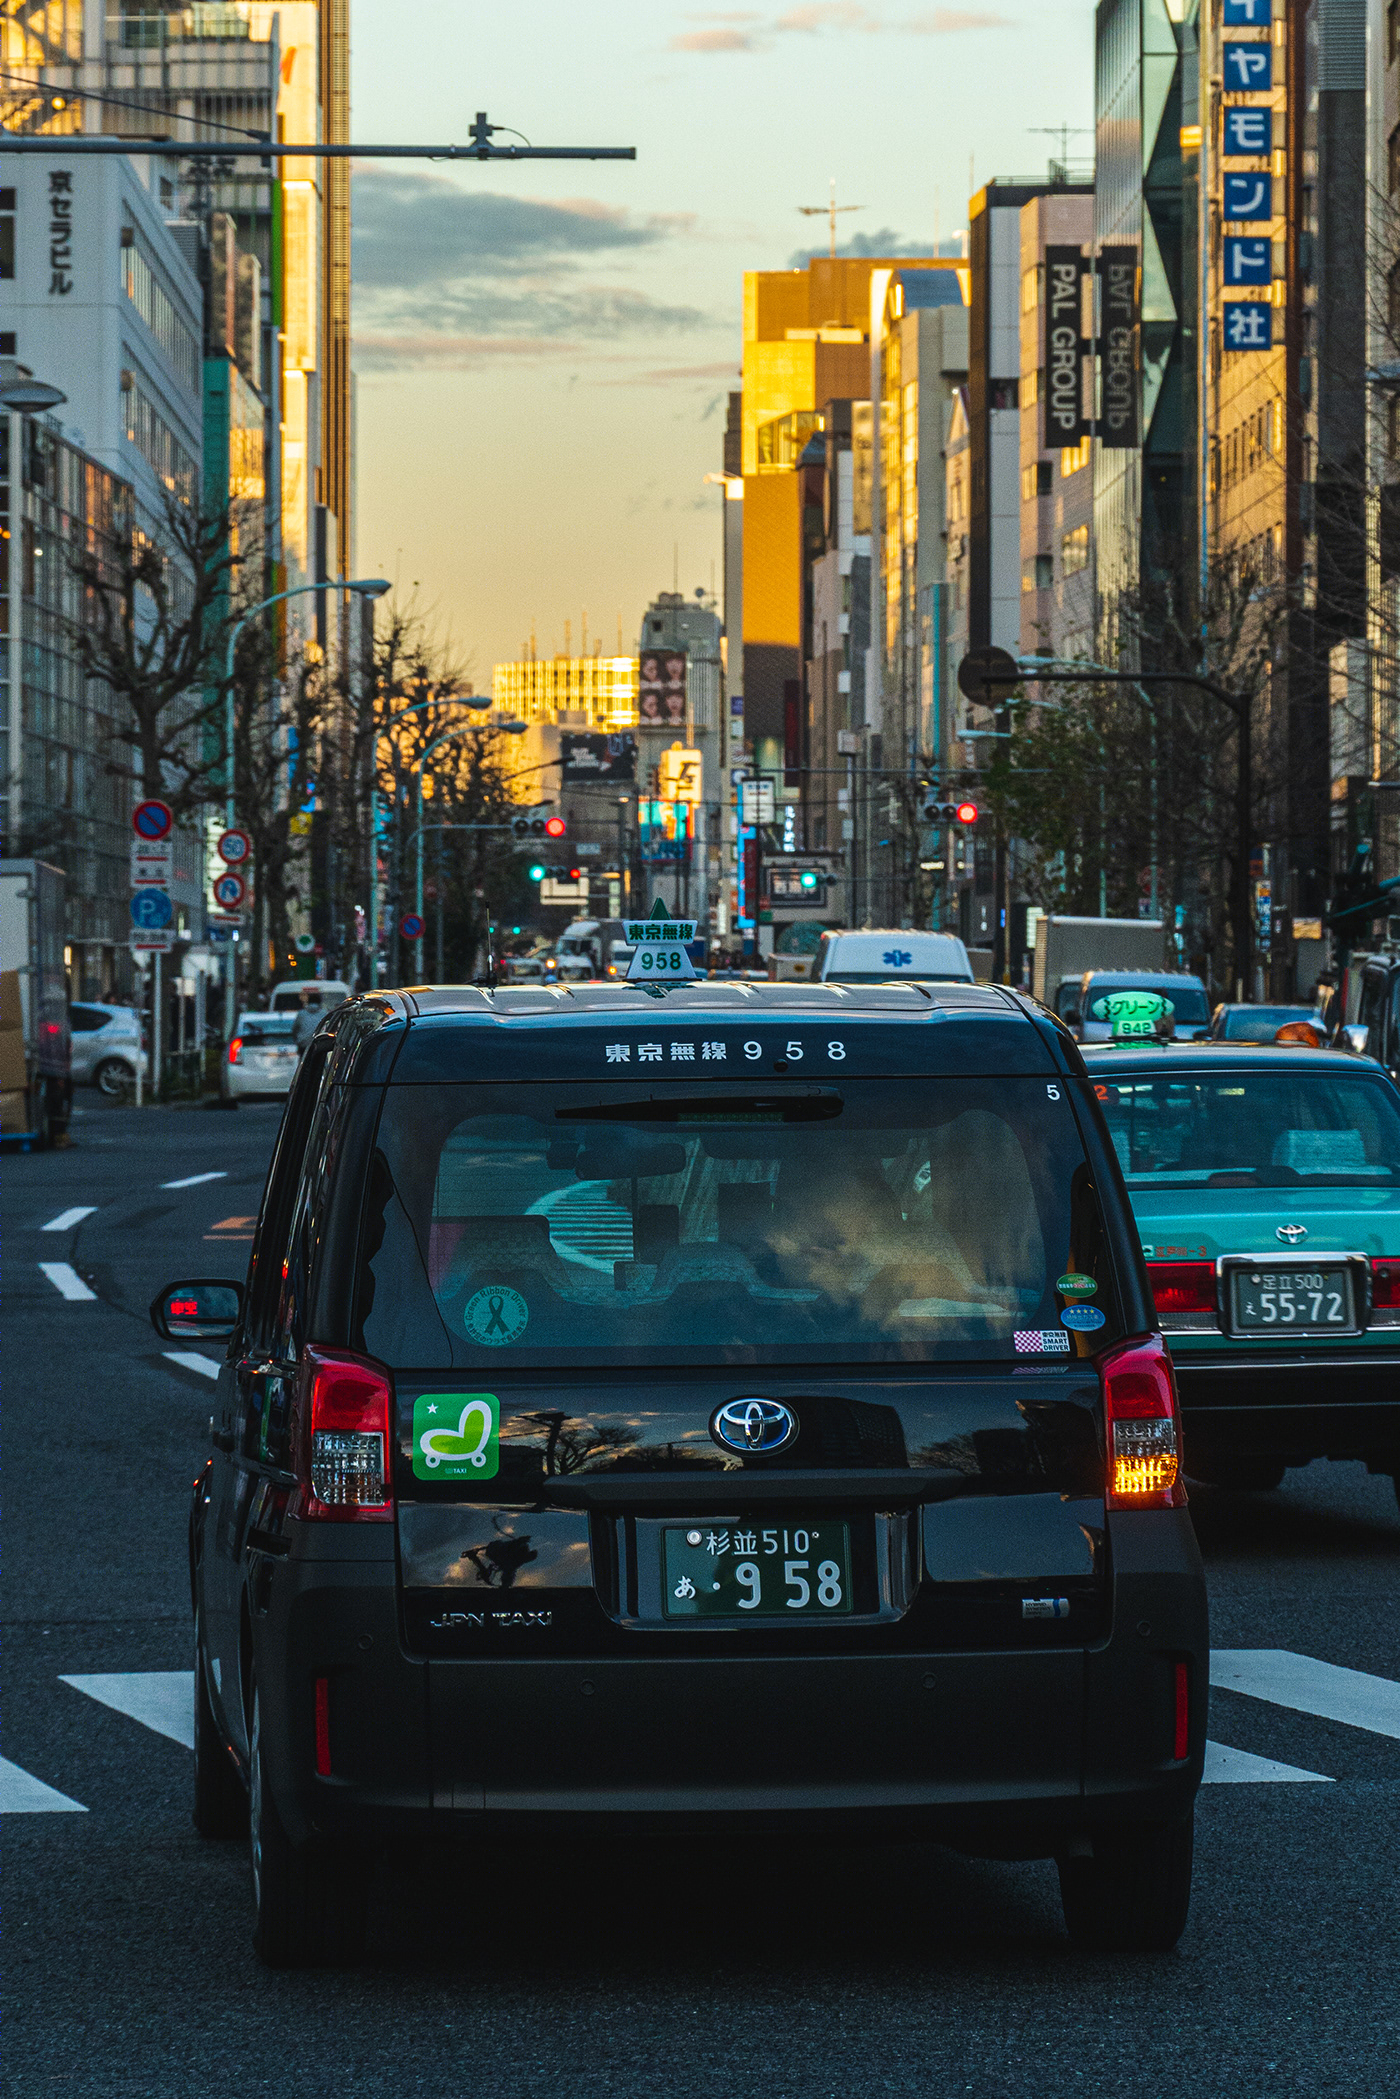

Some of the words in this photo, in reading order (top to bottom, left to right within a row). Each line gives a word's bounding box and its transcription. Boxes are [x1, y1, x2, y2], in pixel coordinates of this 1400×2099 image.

[49, 169, 73, 295] 京セラビル
[1052, 264, 1077, 320] PAL
[1052, 327, 1077, 430] GROUP
[628, 924, 693, 940] 東京無線
[641, 952, 681, 970] 958
[1111, 1000, 1160, 1015] グリーン
[1046, 1084, 1061, 1100] 5
[465, 1297, 480, 1320] Green
[480, 1287, 511, 1298] Ribbon
[511, 1293, 527, 1318] Driver
[1260, 1292, 1344, 1322] 55-72
[674, 1575, 696, 1600] あ
[430, 1611, 485, 1627] JPN
[492, 1611, 552, 1627] TAXI
